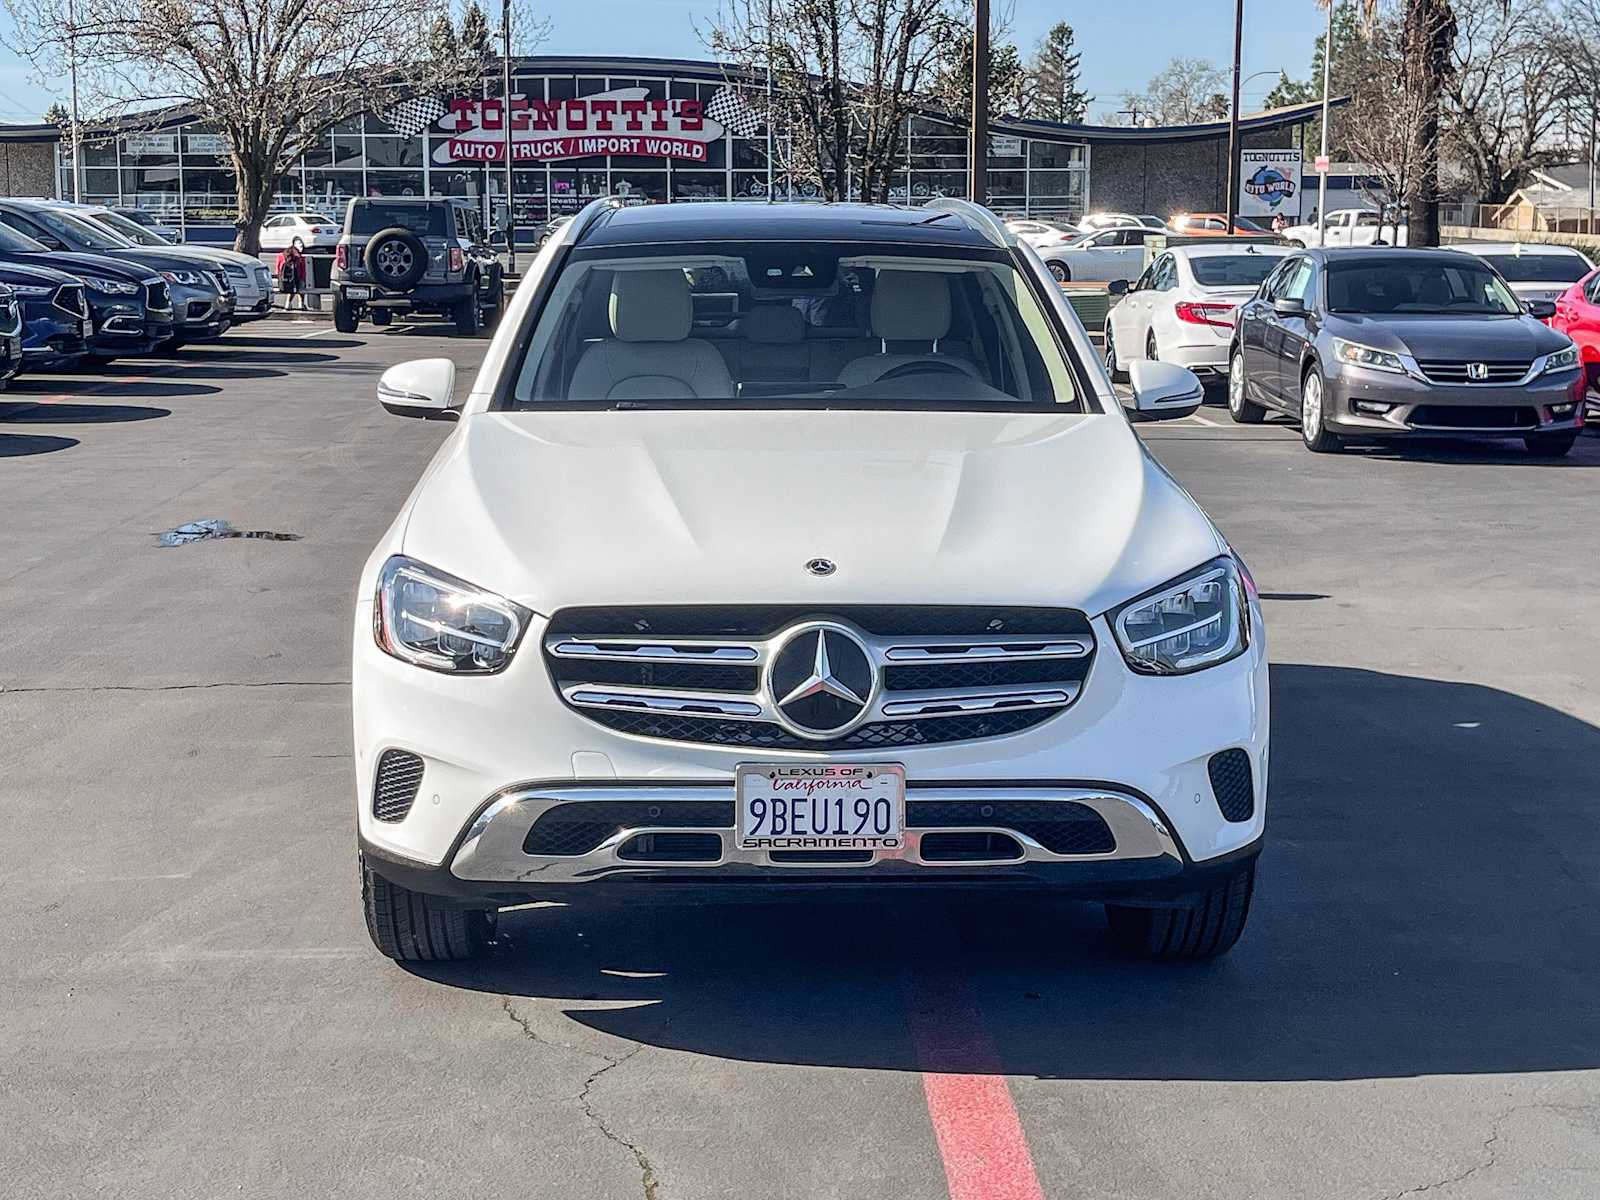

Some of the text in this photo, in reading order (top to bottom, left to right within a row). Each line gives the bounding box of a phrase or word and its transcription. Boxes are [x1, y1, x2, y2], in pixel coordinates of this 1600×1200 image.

[449, 98, 704, 132] TOGNOTTI'S
[453, 142, 497, 159] AUTO
[512, 141, 565, 158] TRUCK
[578, 139, 641, 154] IMPORT
[646, 139, 704, 159] WORLD
[1266, 181, 1295, 193] WORLD
[777, 768, 864, 776] LEXUS OF
[772, 778, 872, 797] California
[749, 798, 891, 836] 9BEU190
[743, 838, 899, 848] SACRAMENTO
